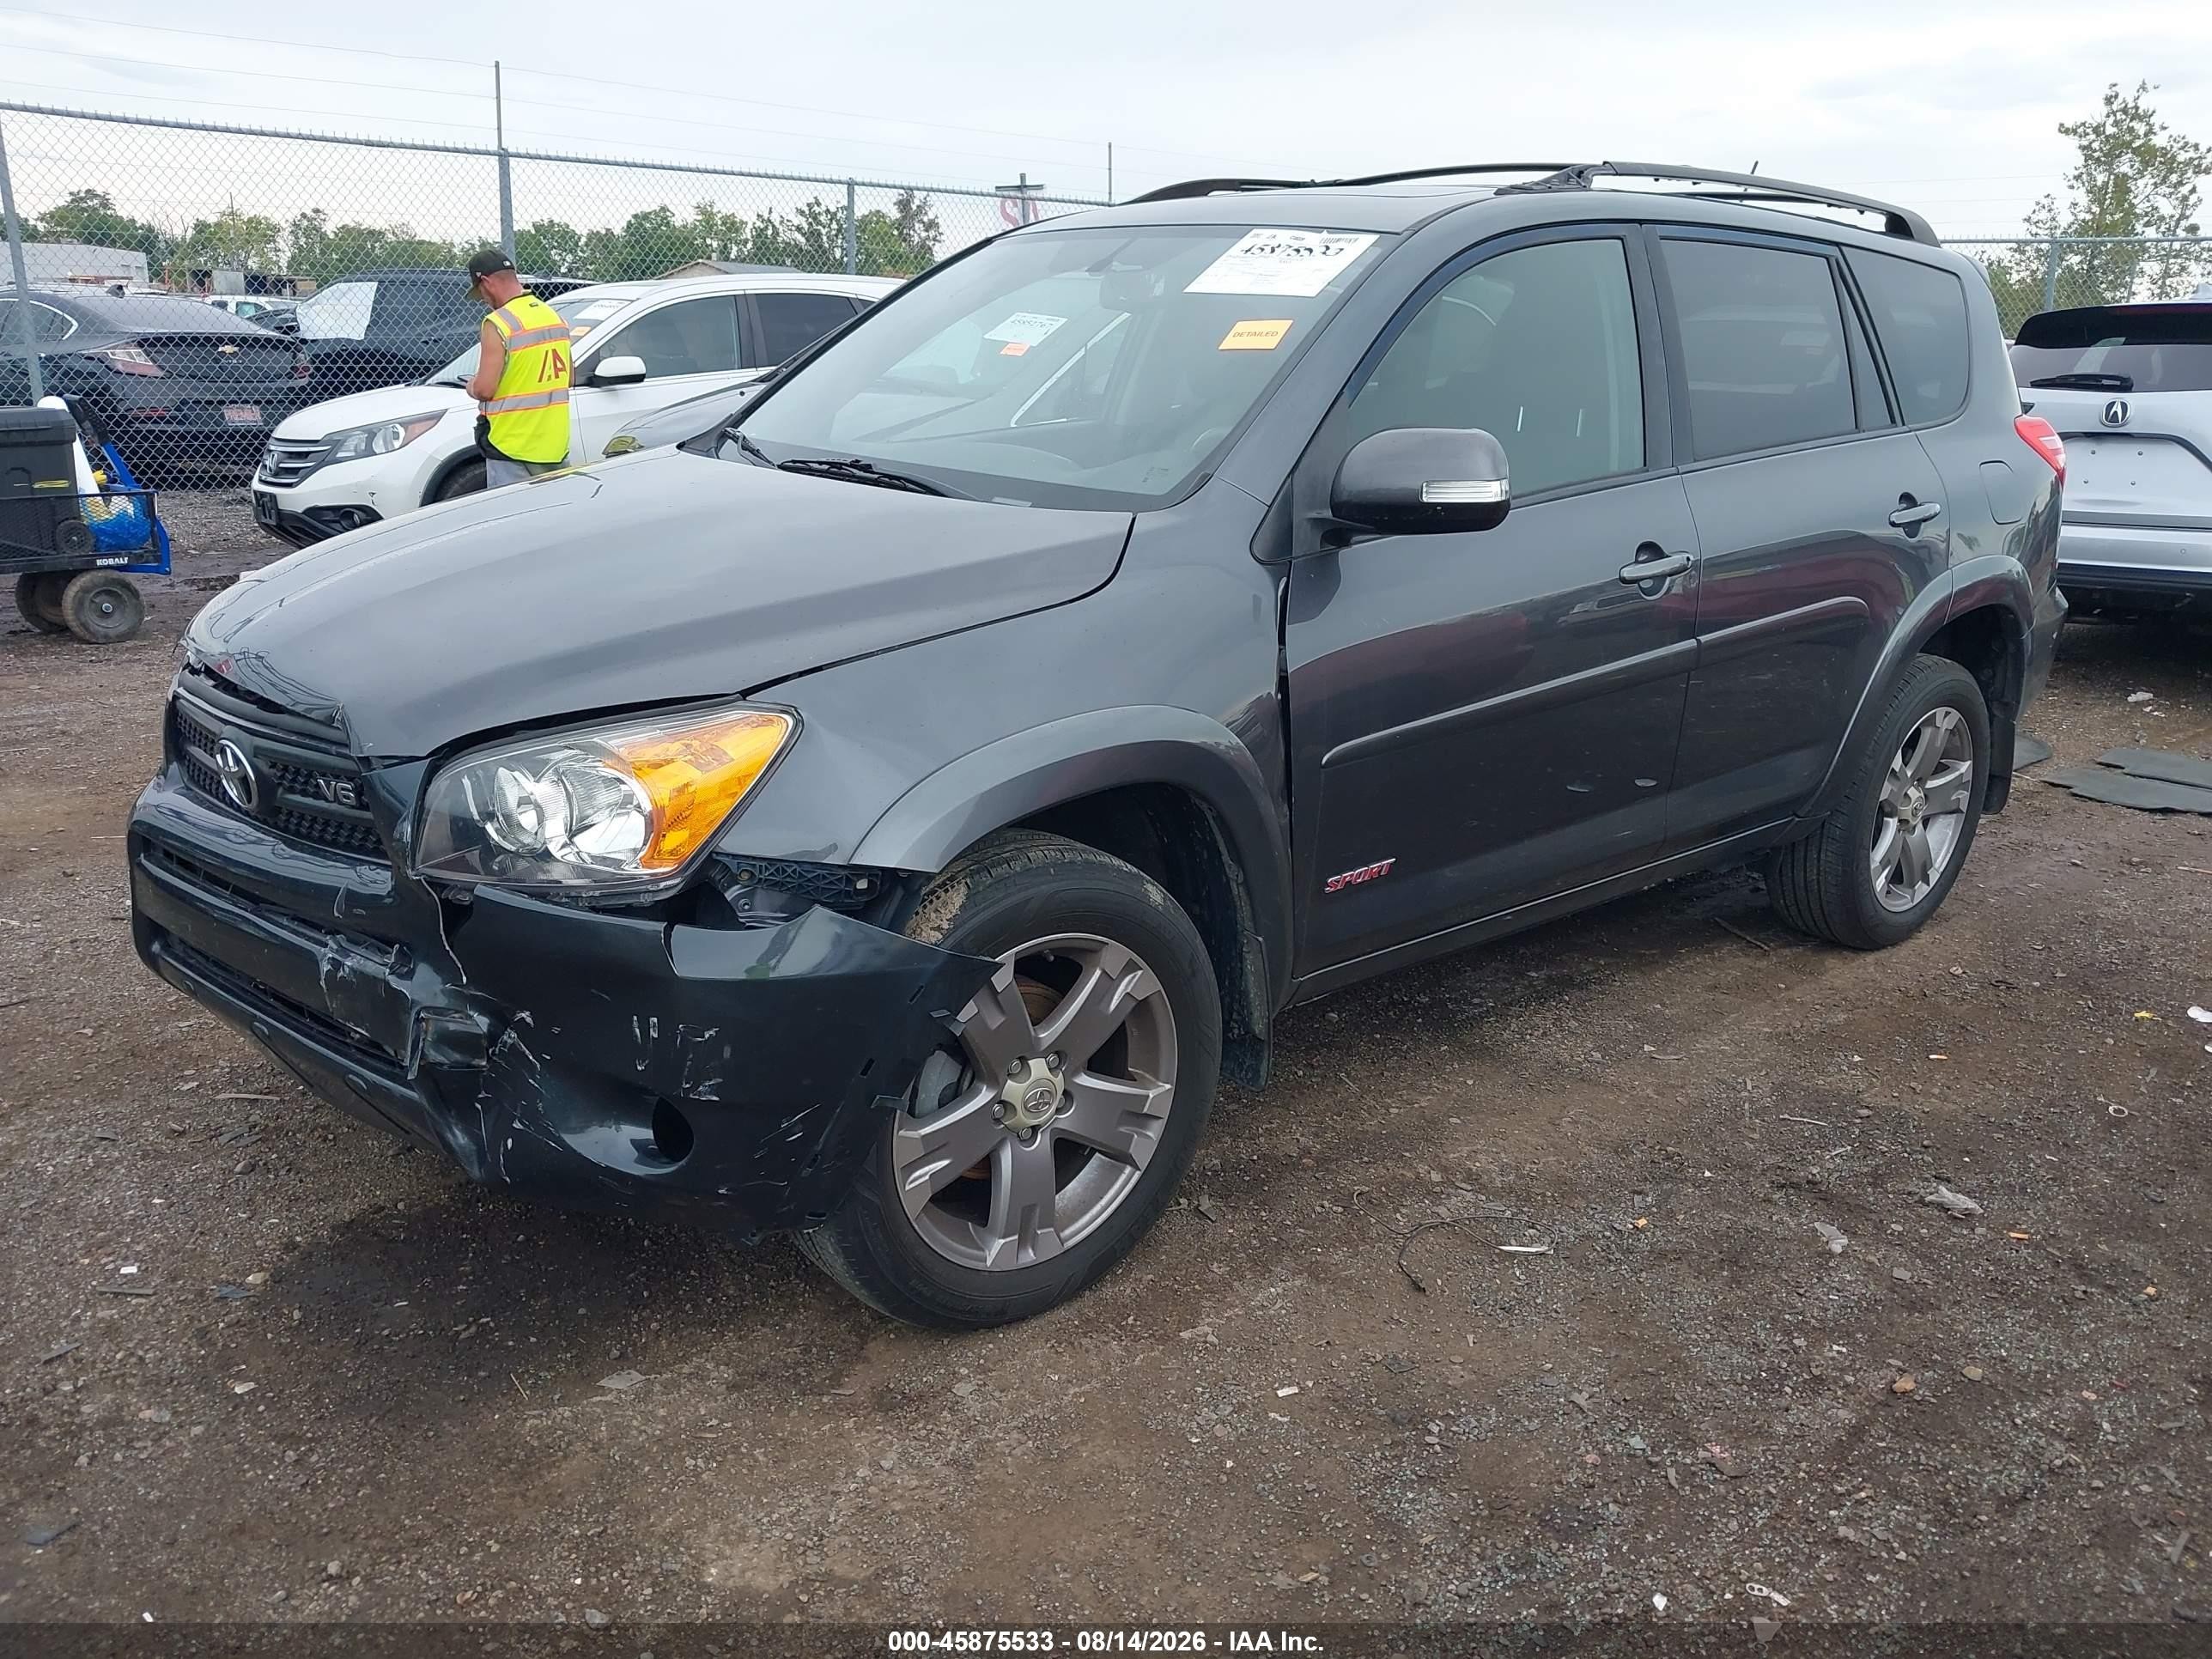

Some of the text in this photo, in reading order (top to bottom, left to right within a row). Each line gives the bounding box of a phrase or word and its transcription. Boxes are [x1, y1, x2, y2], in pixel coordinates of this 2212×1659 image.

[95, 556, 129, 566] KOBALT
[316, 776, 357, 806] V6
[1324, 858, 1396, 894] SPORT
